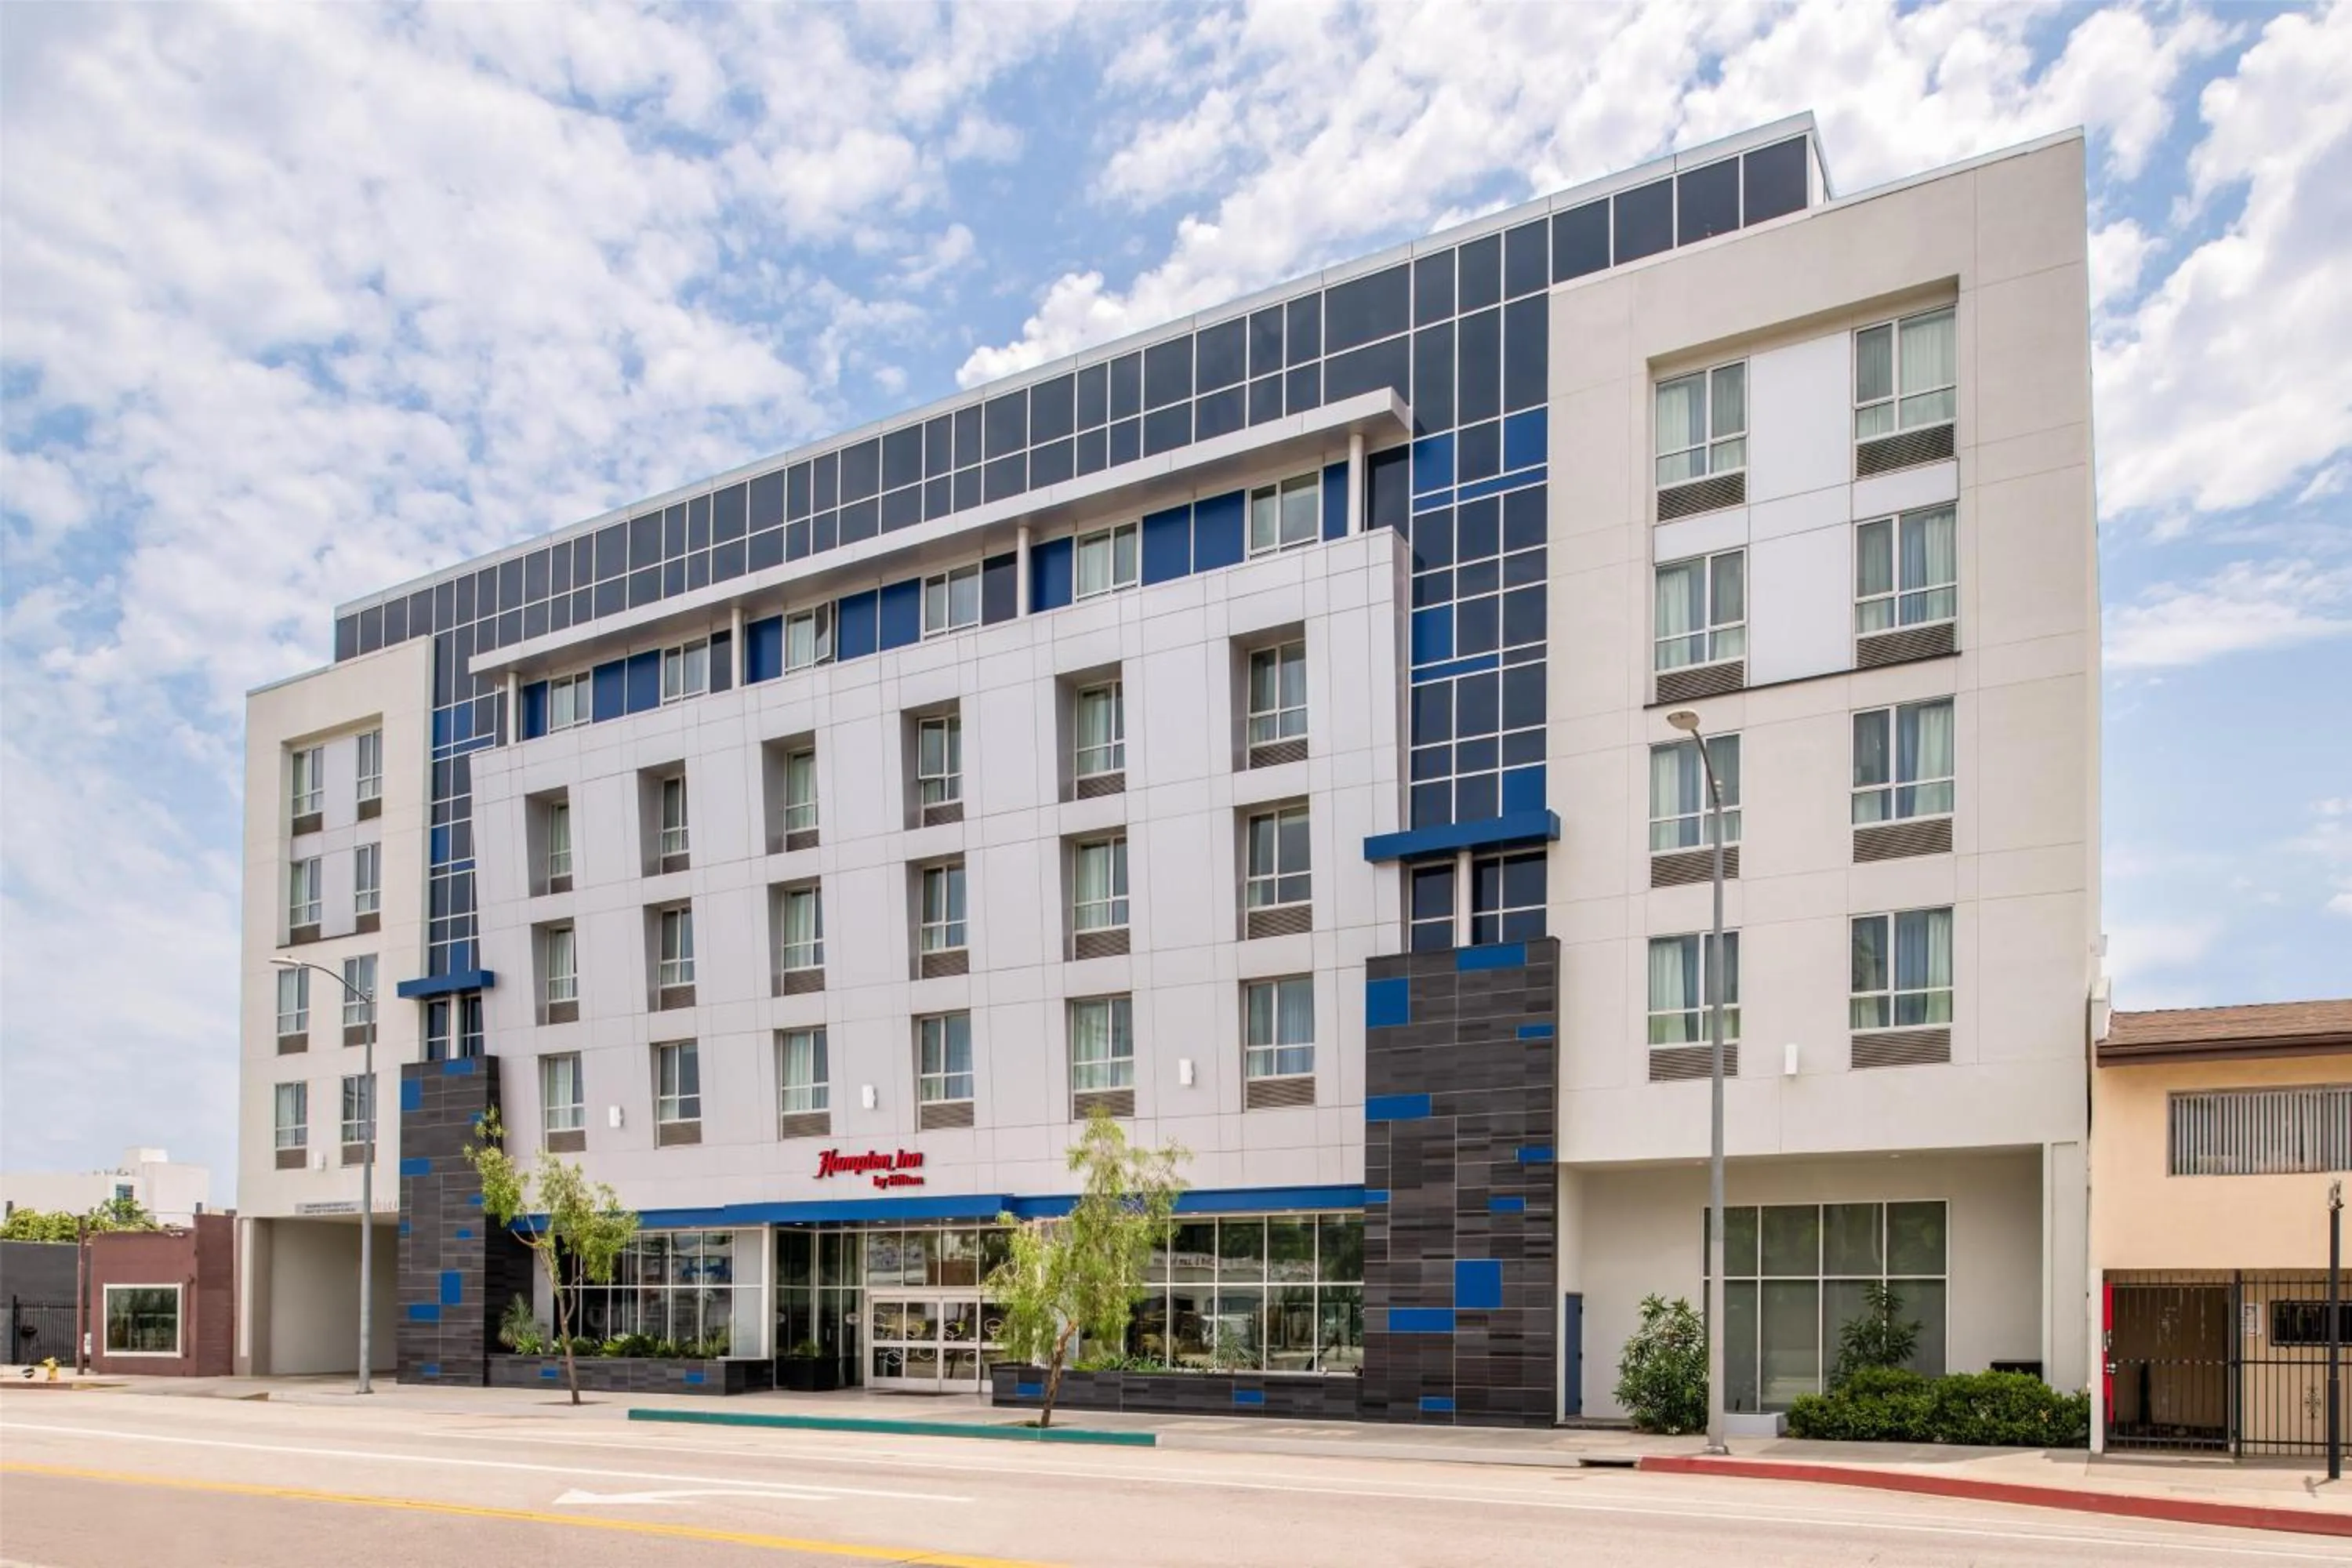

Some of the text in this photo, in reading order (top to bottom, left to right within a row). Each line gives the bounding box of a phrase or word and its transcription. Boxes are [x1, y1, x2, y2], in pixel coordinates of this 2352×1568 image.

[813, 1149, 924, 1179] Hampton Inn
[873, 1174, 924, 1189] by Hilton
